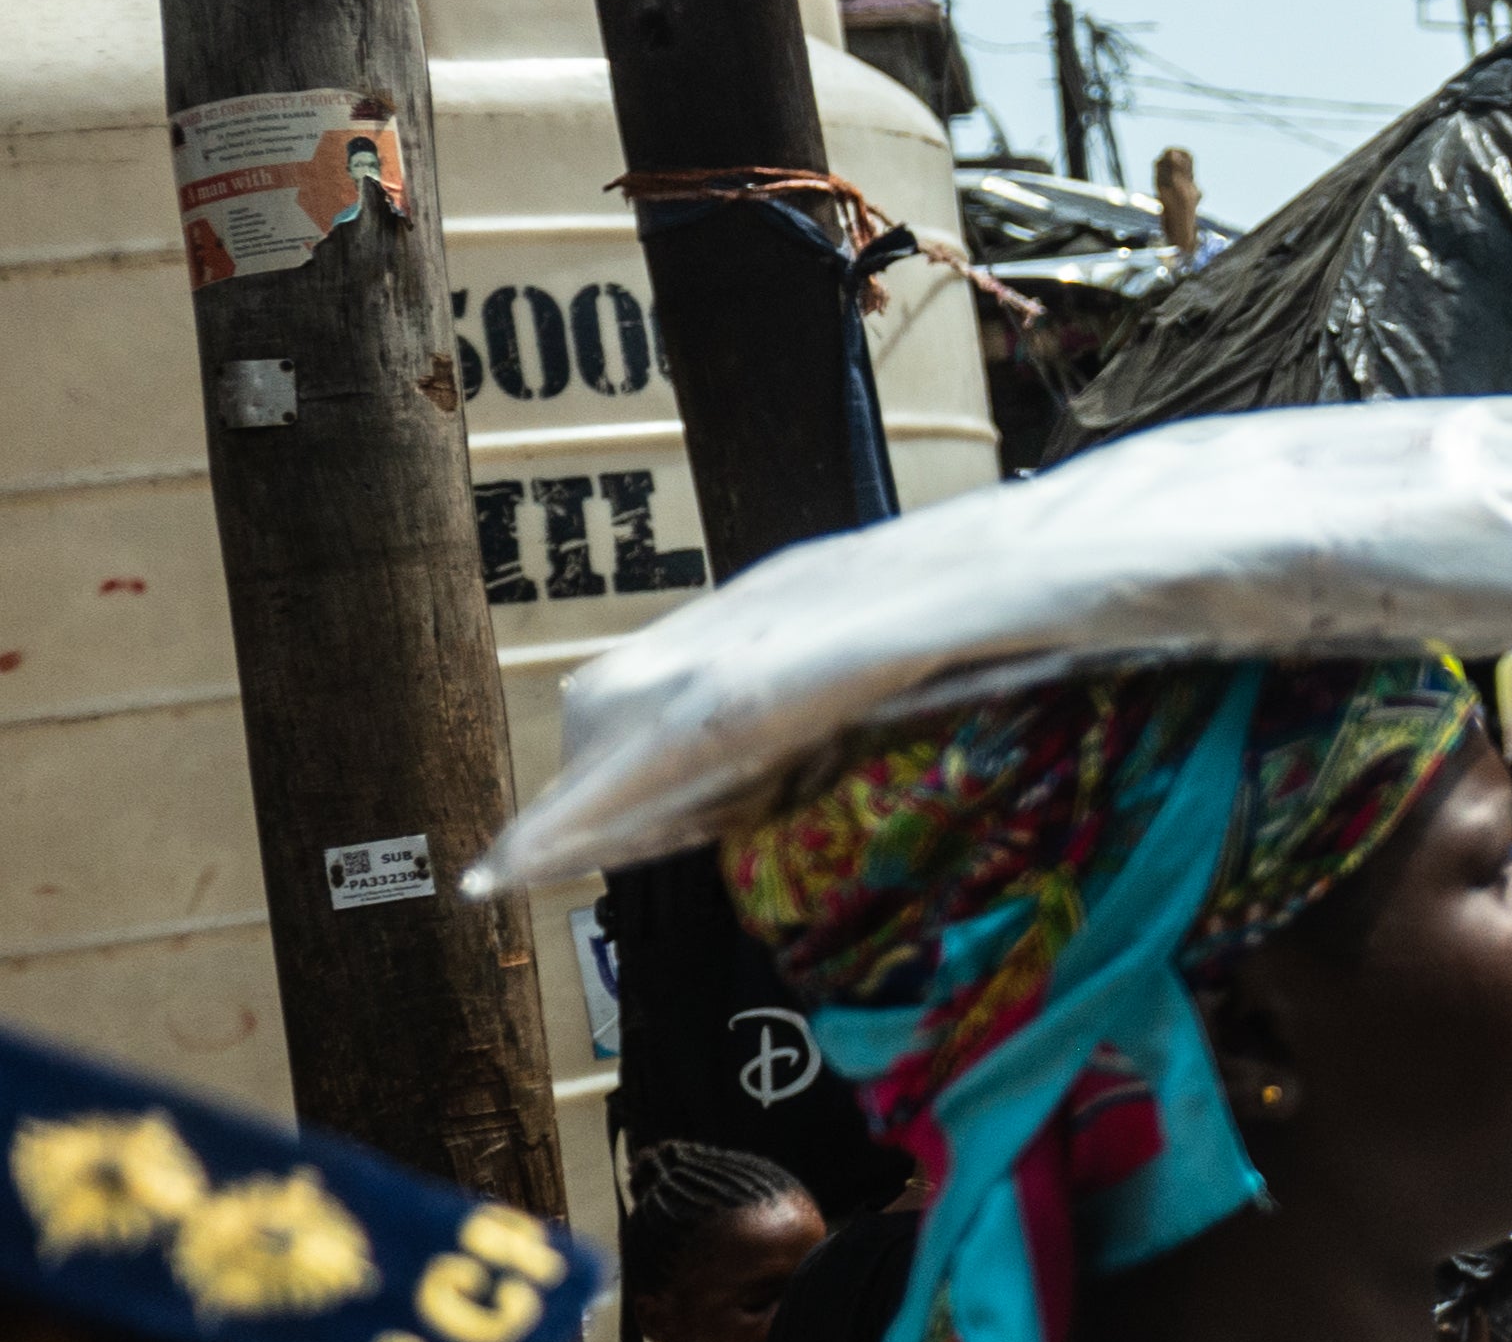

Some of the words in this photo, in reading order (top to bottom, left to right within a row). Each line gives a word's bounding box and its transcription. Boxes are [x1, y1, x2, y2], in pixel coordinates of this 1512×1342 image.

[197, 179, 227, 200] man
[231, 168, 273, 193] with
[380, 850, 414, 865] SUB
